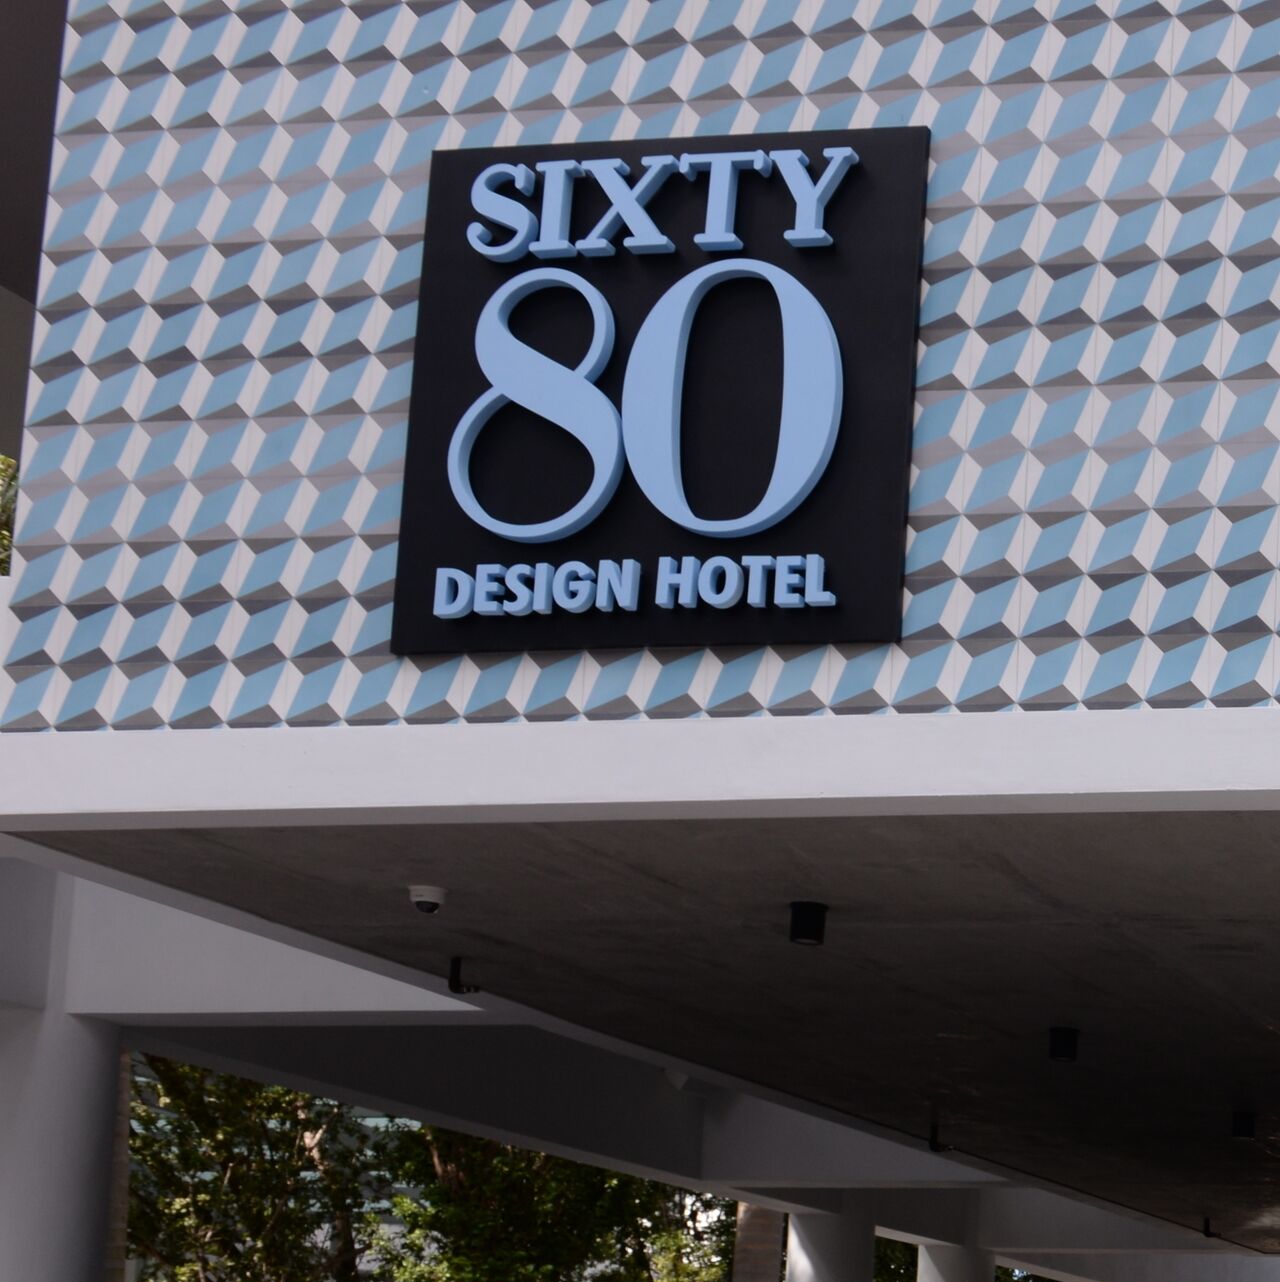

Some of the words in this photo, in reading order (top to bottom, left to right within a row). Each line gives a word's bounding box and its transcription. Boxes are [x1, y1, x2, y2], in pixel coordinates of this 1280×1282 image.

[466, 146, 860, 263] SIXTY
[447, 258, 844, 545] 80
[432, 558, 641, 620] DESIGN
[654, 553, 837, 611] HOTEL
